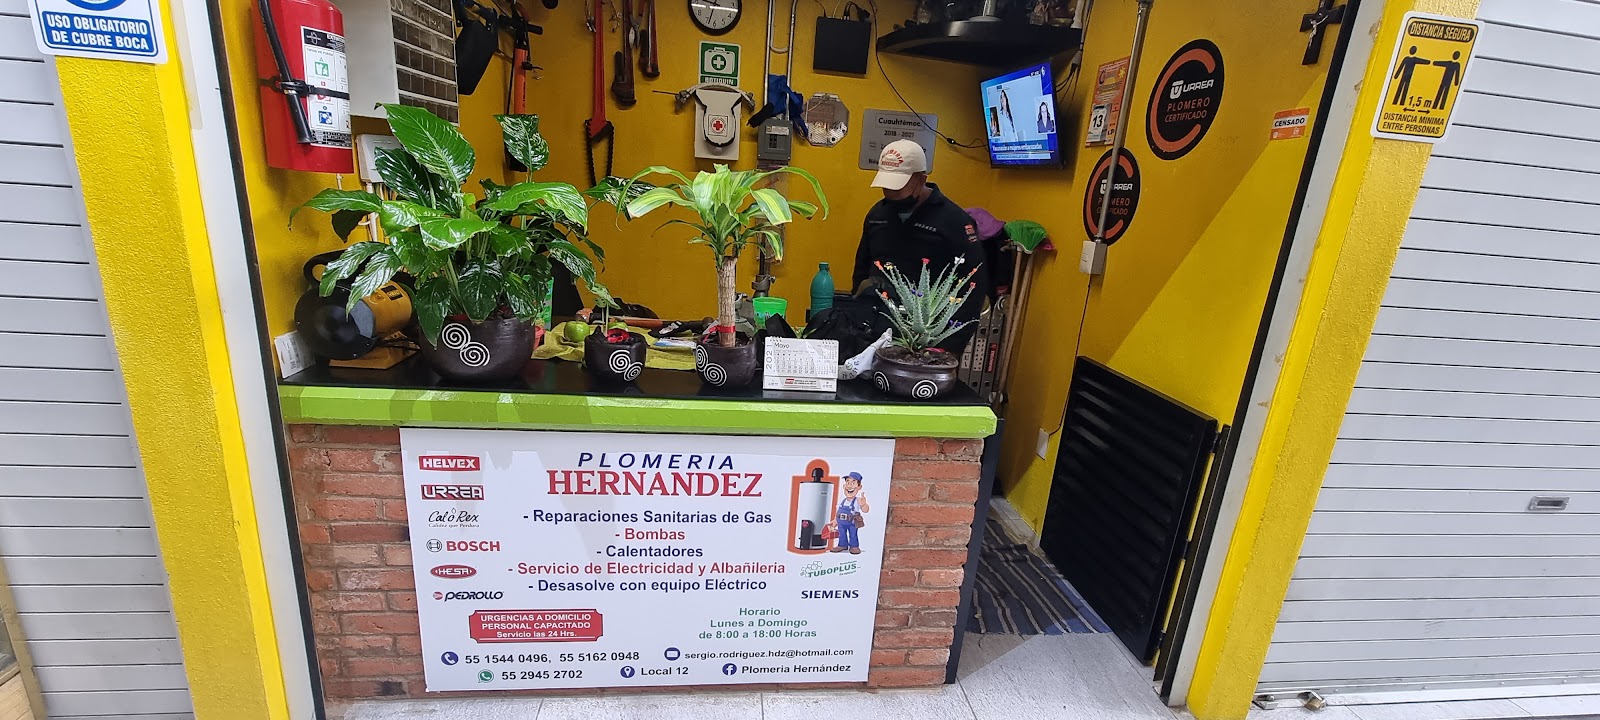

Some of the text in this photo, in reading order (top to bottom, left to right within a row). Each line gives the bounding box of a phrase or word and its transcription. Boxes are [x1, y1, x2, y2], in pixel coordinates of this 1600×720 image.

[46, 13, 148, 36] USO OBLIGATORIO
[1409, 22, 1472, 41] DISTANCIA SEGURA
[51, 30, 150, 50] DE CUBRE BOCA
[1183, 79, 1214, 92] URREA
[1167, 97, 1211, 112] PLOMERO
[1408, 95, 1432, 108] 1,5 m
[1092, 114, 1104, 128] 13
[1165, 110, 1208, 123] CERTIFICADO
[1274, 117, 1306, 127] CENSADO
[1383, 112, 1445, 126] DISTANCIA MINIMA
[1382, 122, 1441, 134] ENTRE PERSONAS
[1111, 183, 1133, 191] RREA
[765, 344, 773, 370] 2021
[422, 458, 476, 469] HELVEX
[577, 452, 735, 470] PLOMERIA
[546, 470, 763, 497] HERNANDEZ
[422, 485, 484, 499] URREA
[533, 509, 639, 525] Reparaciones
[643, 510, 717, 524] Sanitarias
[722, 511, 739, 523] de
[744, 511, 772, 524] Gas
[624, 528, 686, 540] Bombas
[446, 540, 501, 552] BOSCH
[606, 545, 703, 557] Calentadores
[517, 562, 579, 575] Servicio
[583, 563, 602, 574] de
[607, 562, 694, 575] Electricidad
[698, 565, 705, 577] y
[710, 562, 786, 574] Albañileria
[807, 563, 857, 578] TUBOPLUS
[538, 579, 615, 592] Desasolve
[619, 581, 647, 591] con
[651, 580, 701, 593] equipo
[705, 579, 767, 591] Eléctrico
[444, 591, 504, 602] PEDROLLO
[801, 589, 859, 599] SIEMENS
[480, 614, 535, 622] URGENCIAS
[545, 613, 592, 621] DOMICILIO
[739, 607, 781, 616] Horario
[481, 622, 591, 630] PERSONAL CAPACITADO
[710, 619, 745, 628] Lunes
[757, 618, 808, 629] Domingo
[560, 630, 577, 638] Hrs.
[698, 631, 712, 639] de
[715, 631, 740, 639] 8:00
[752, 630, 782, 638] 18:00
[784, 629, 817, 638] Horas
[465, 651, 640, 665] 55 1544 0496, 55 5162 0948
[684, 648, 854, 661] sergio.rodriguez.hdz@hotmail.com
[501, 669, 583, 680] 55 2945 2702
[641, 666, 689, 676] Local 12
[741, 662, 851, 674] Plomeria Hernández
